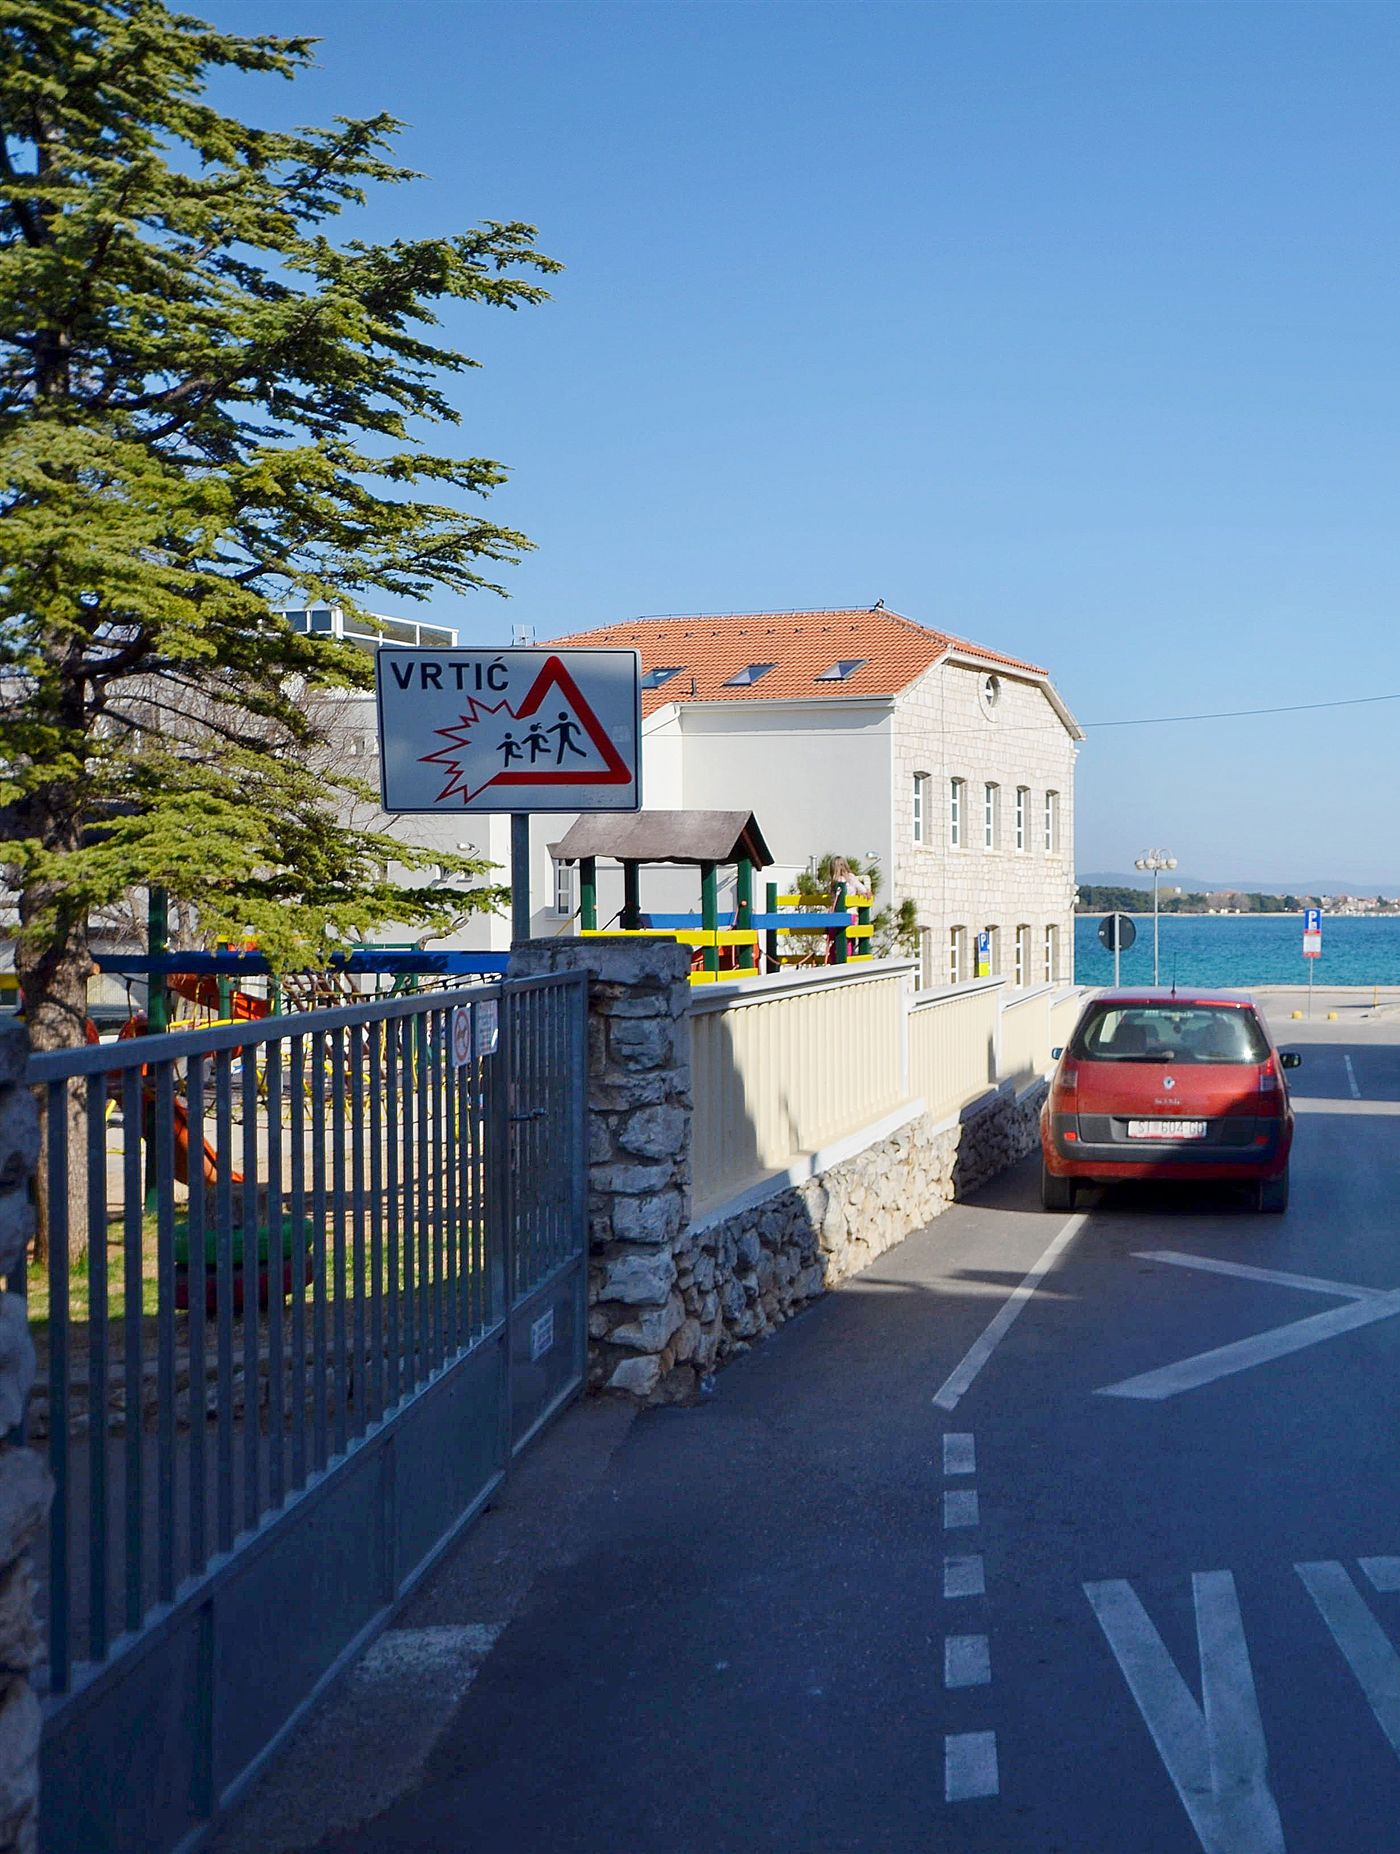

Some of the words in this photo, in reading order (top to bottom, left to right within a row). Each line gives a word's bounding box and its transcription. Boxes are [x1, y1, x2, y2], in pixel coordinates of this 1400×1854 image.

[390, 656, 510, 692] VRTIĆ
[1308, 910, 1318, 930] P
[980, 934, 987, 948] P
